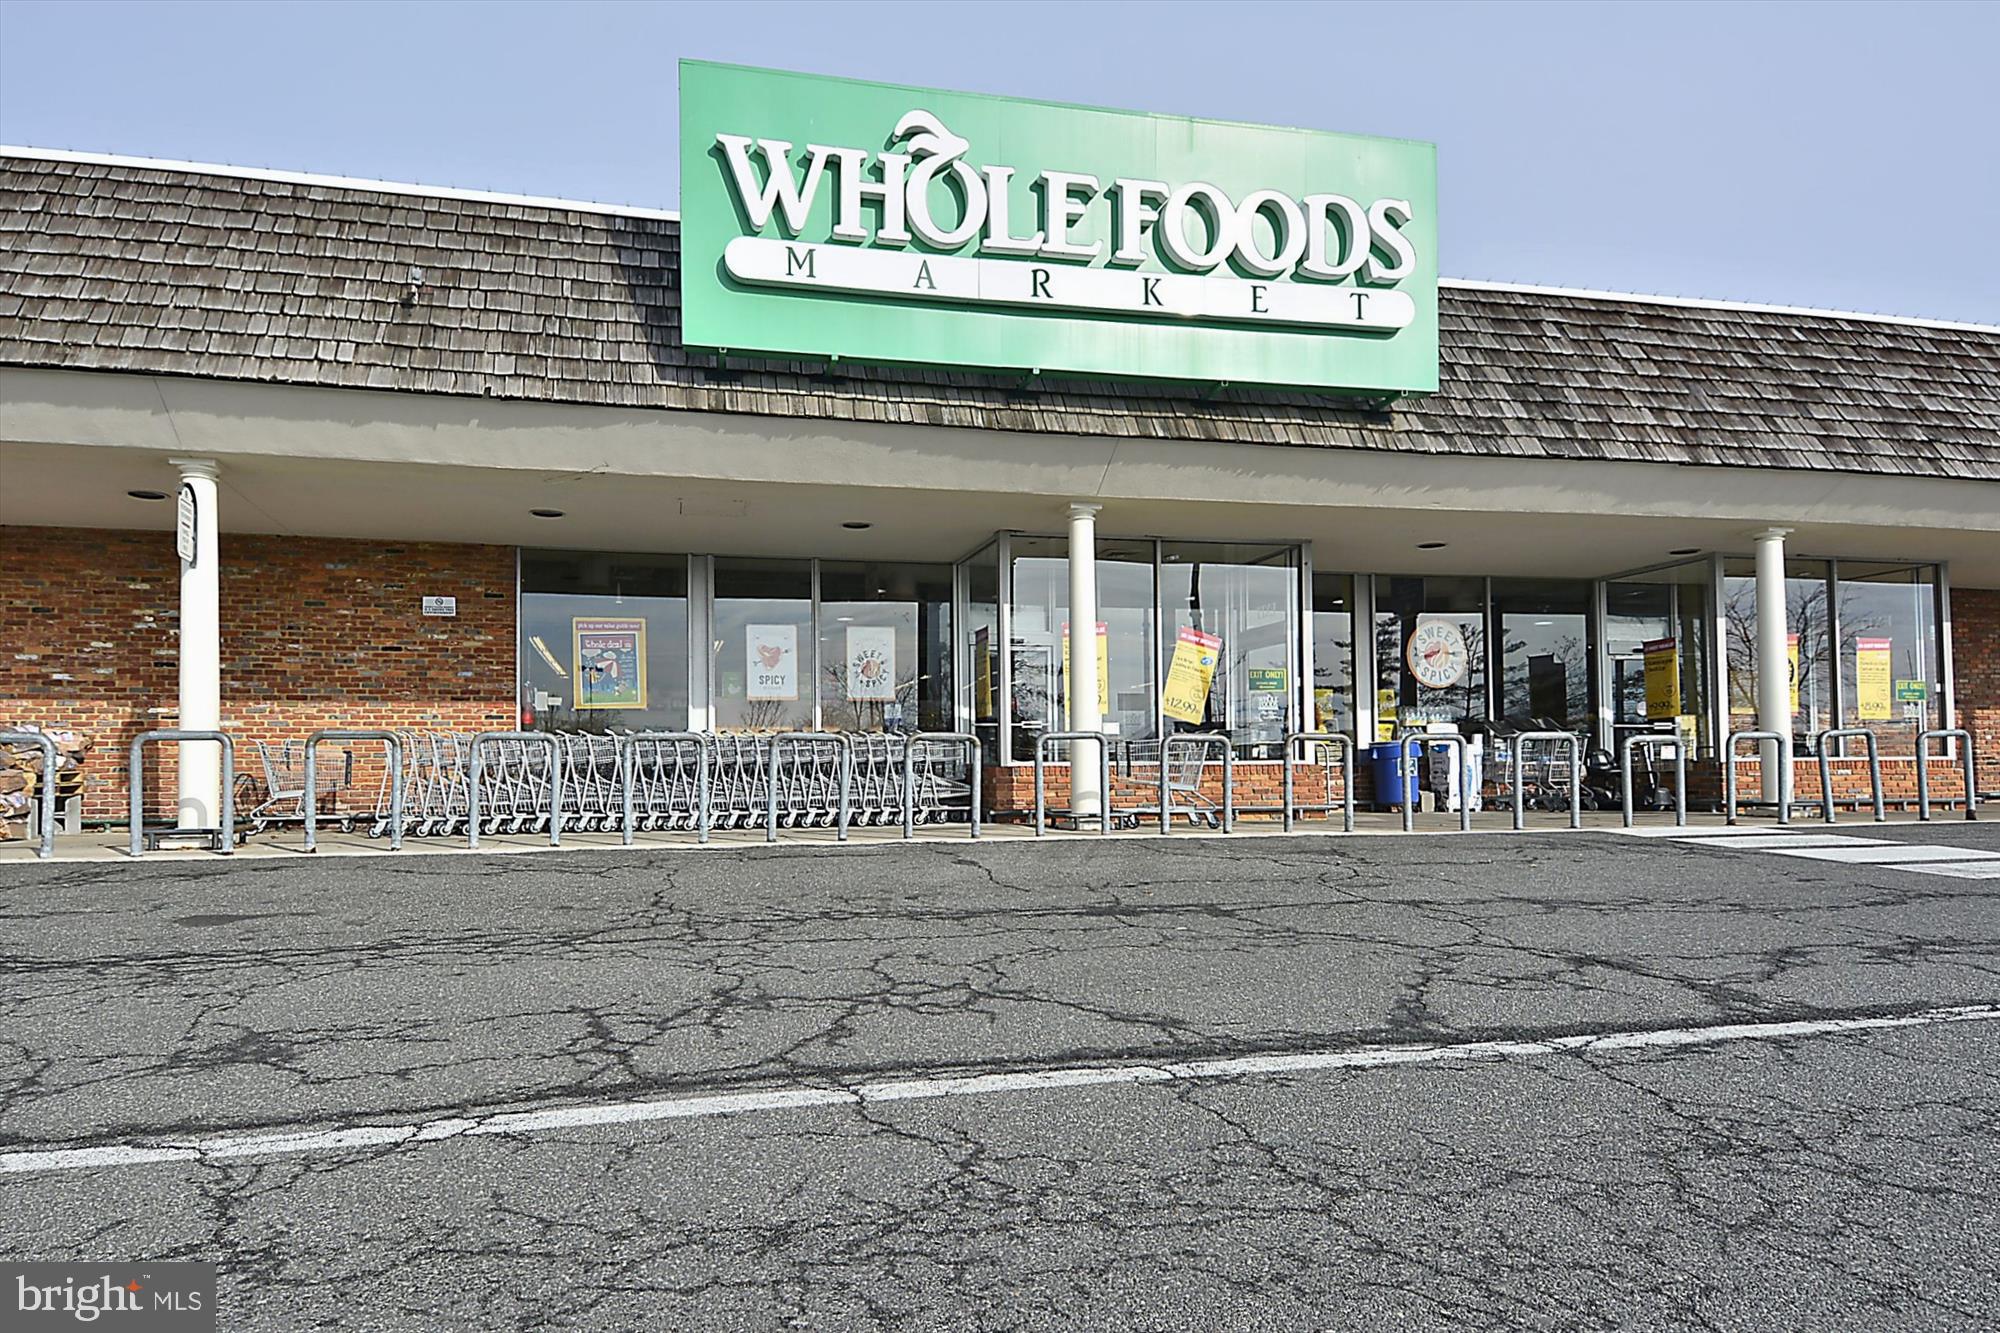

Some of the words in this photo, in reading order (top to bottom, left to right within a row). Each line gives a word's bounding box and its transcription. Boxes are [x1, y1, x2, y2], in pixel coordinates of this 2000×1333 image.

[714, 110, 1103, 258] WHOLE
[1110, 177, 1417, 281] FOODS
[785, 246, 1370, 321] MARKET
[1418, 626, 1459, 646] SWEET
[852, 650, 882, 667] SWEET
[759, 675, 786, 685] SPICY
[865, 669, 889, 688] SPICY
[1421, 663, 1458, 681] SPICY
